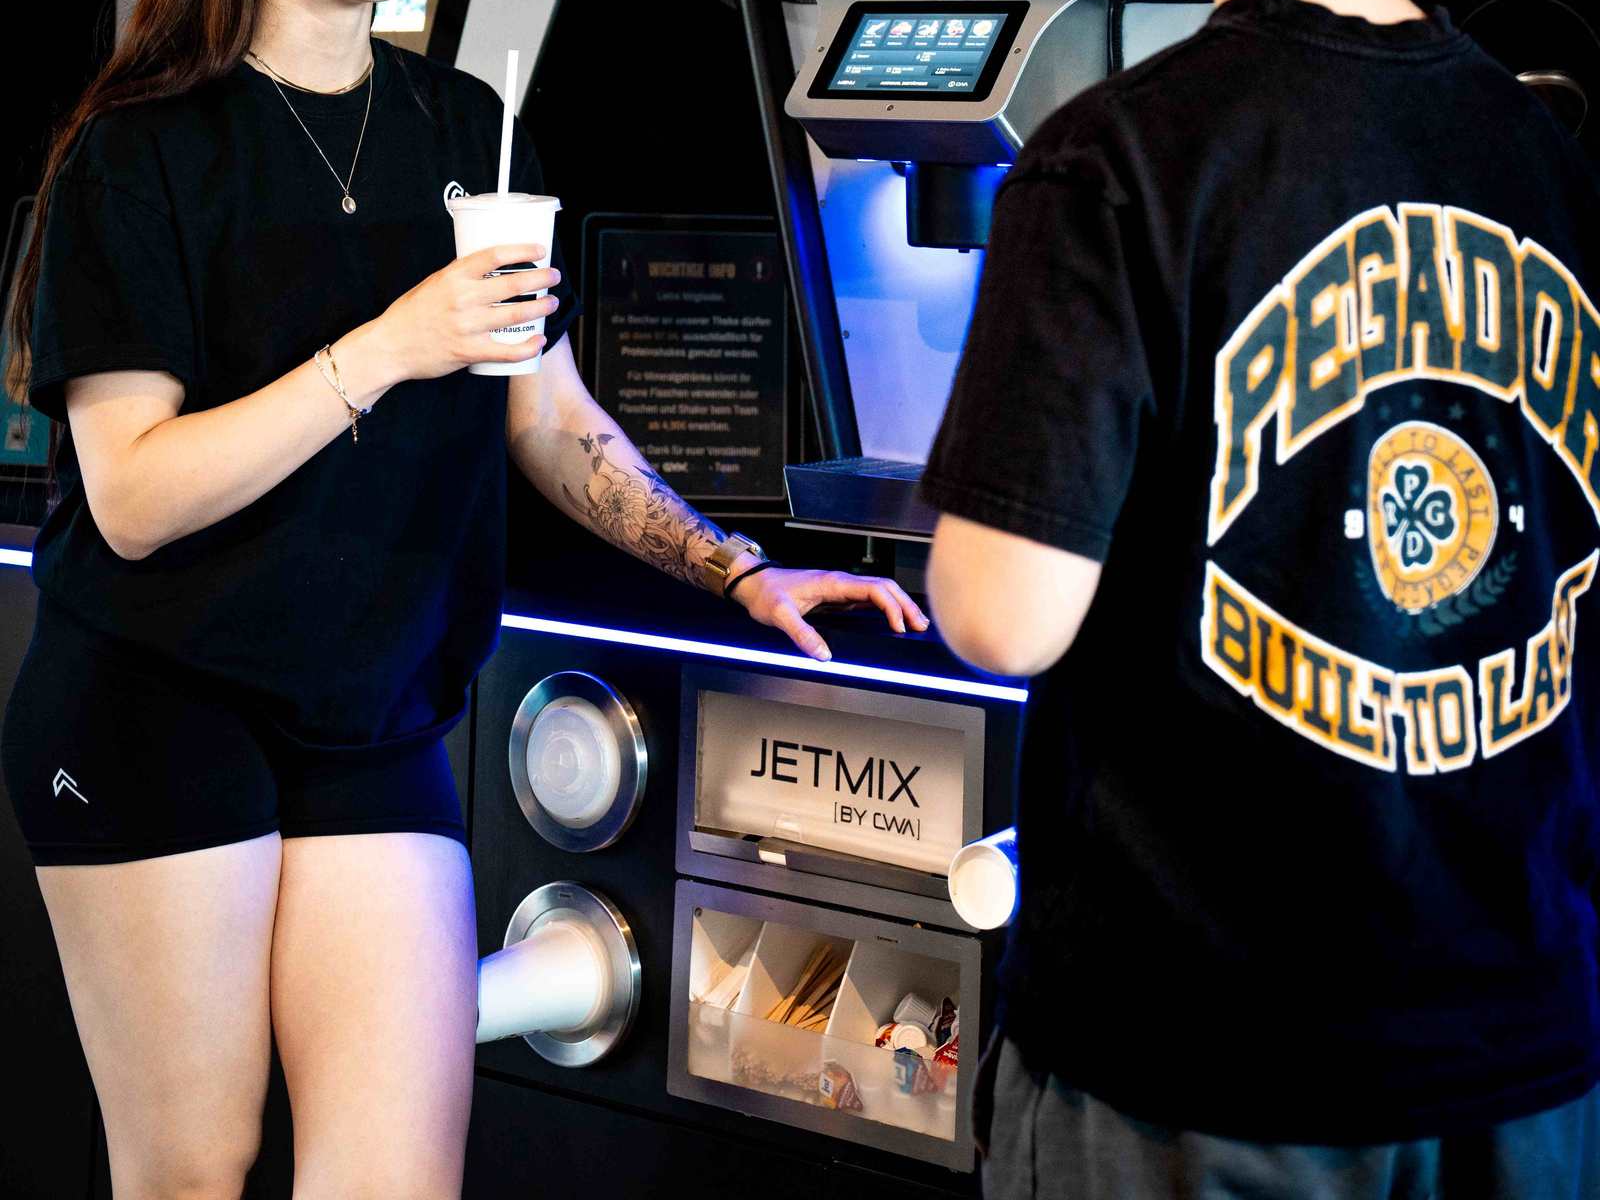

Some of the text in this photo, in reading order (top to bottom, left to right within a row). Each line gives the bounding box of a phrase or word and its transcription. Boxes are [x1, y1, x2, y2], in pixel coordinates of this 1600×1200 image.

[1403, 474, 1420, 501] P
[1424, 499, 1446, 527] G
[1406, 530, 1424, 558] D
[1396, 665, 1476, 775] TO
[750, 738, 922, 808] JETMIX
